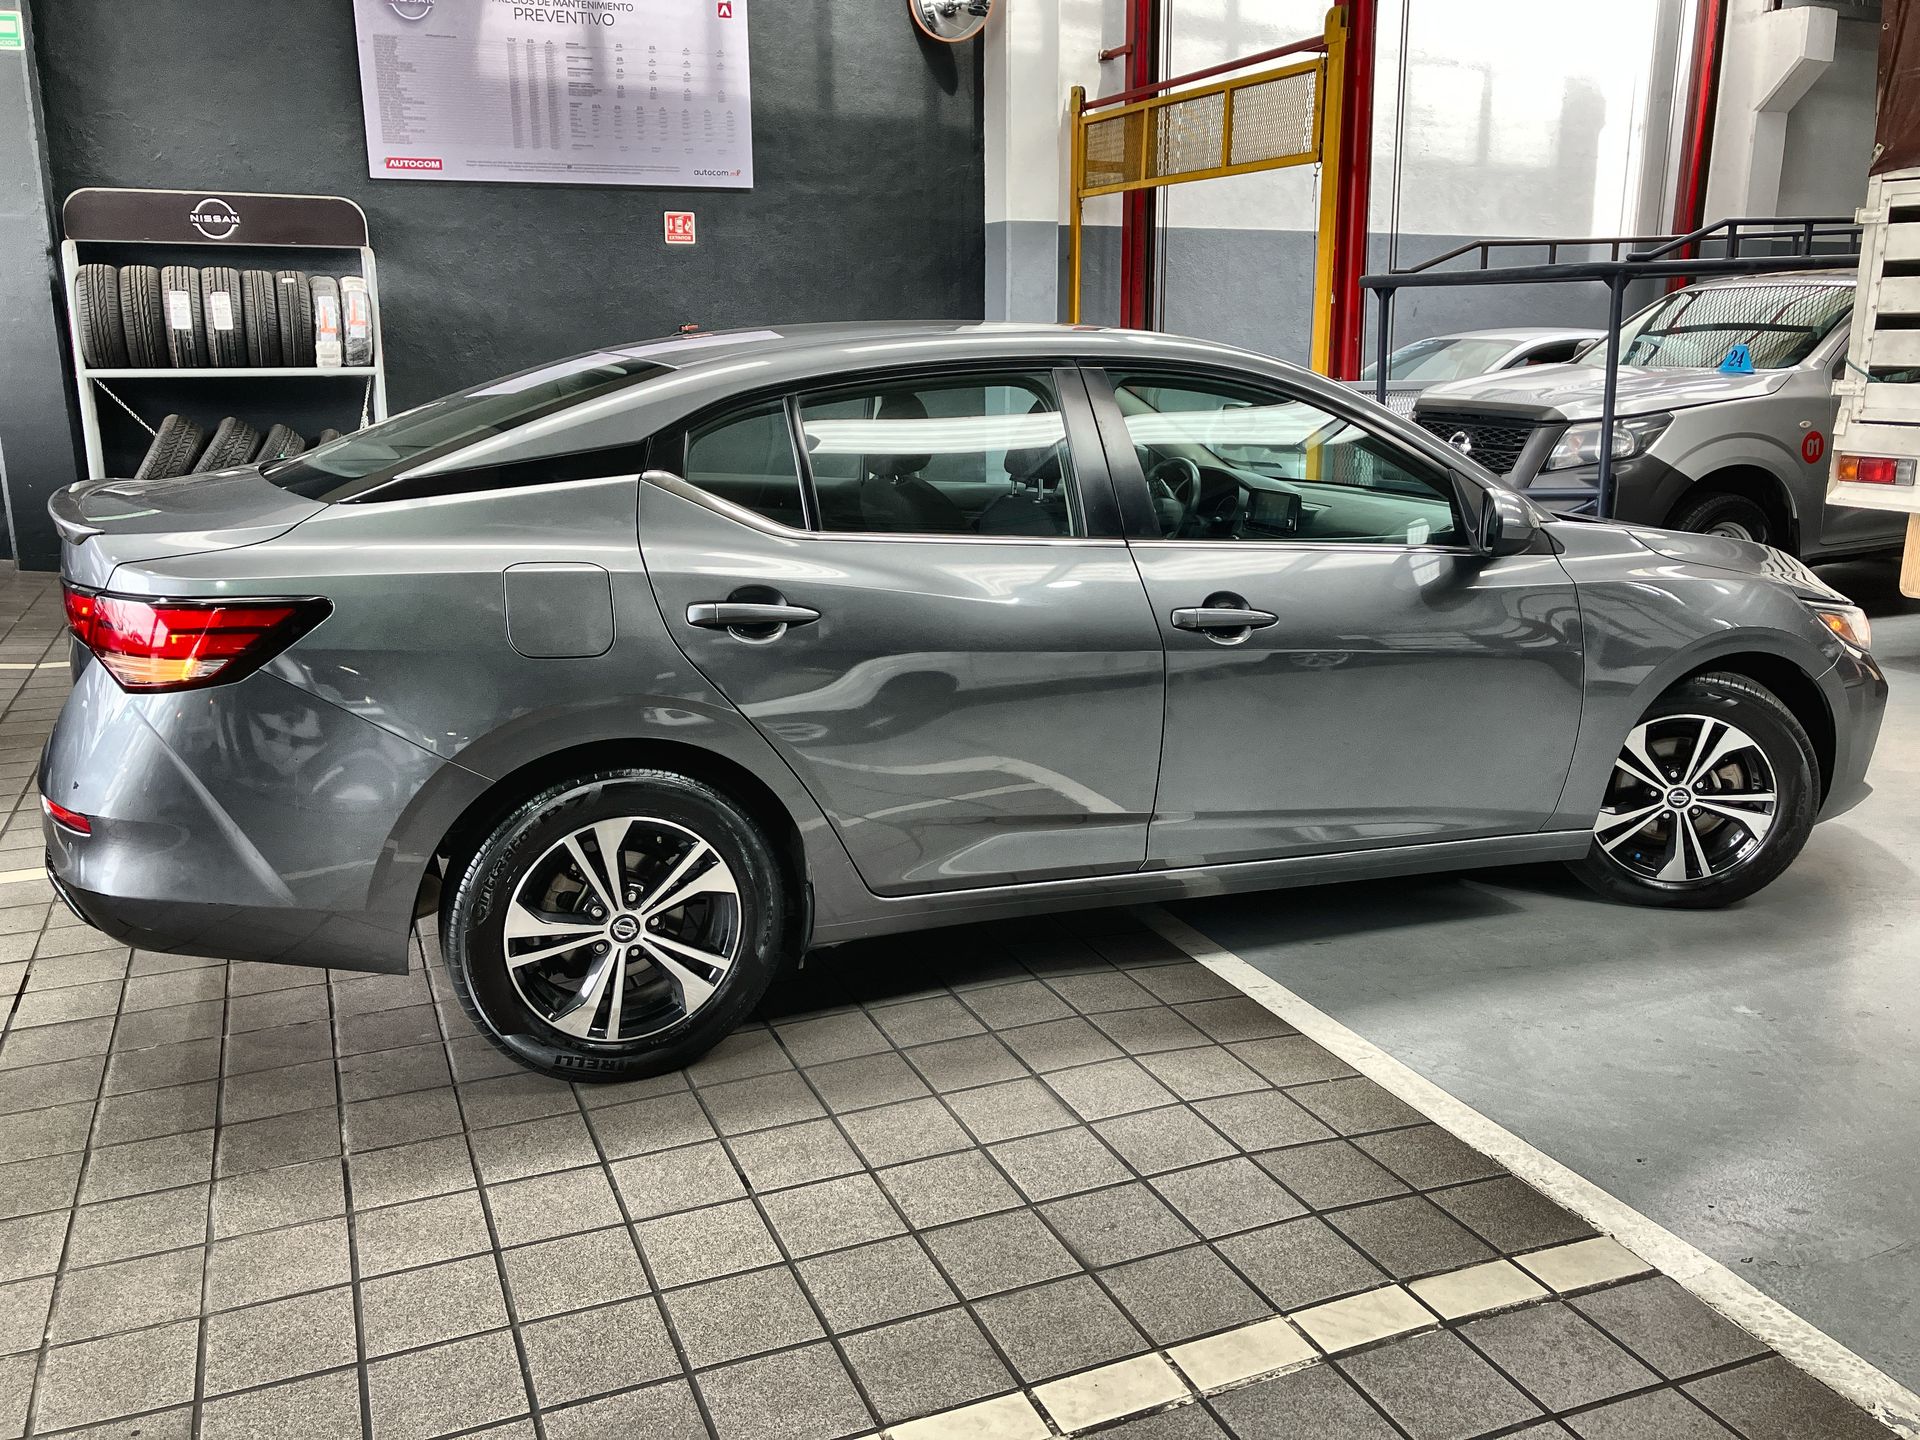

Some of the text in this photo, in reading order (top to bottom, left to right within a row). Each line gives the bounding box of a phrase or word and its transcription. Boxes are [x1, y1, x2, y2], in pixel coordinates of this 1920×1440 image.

[553, 0, 634, 12] MANTENIMIENTO
[513, 6, 615, 27] PREVENTIVO
[388, 159, 441, 169] AUTOCOM
[189, 213, 241, 224] NISSAN
[1728, 349, 1746, 368] 24
[1806, 437, 1820, 457] 01
[553, 1054, 631, 1073] IRELLI
